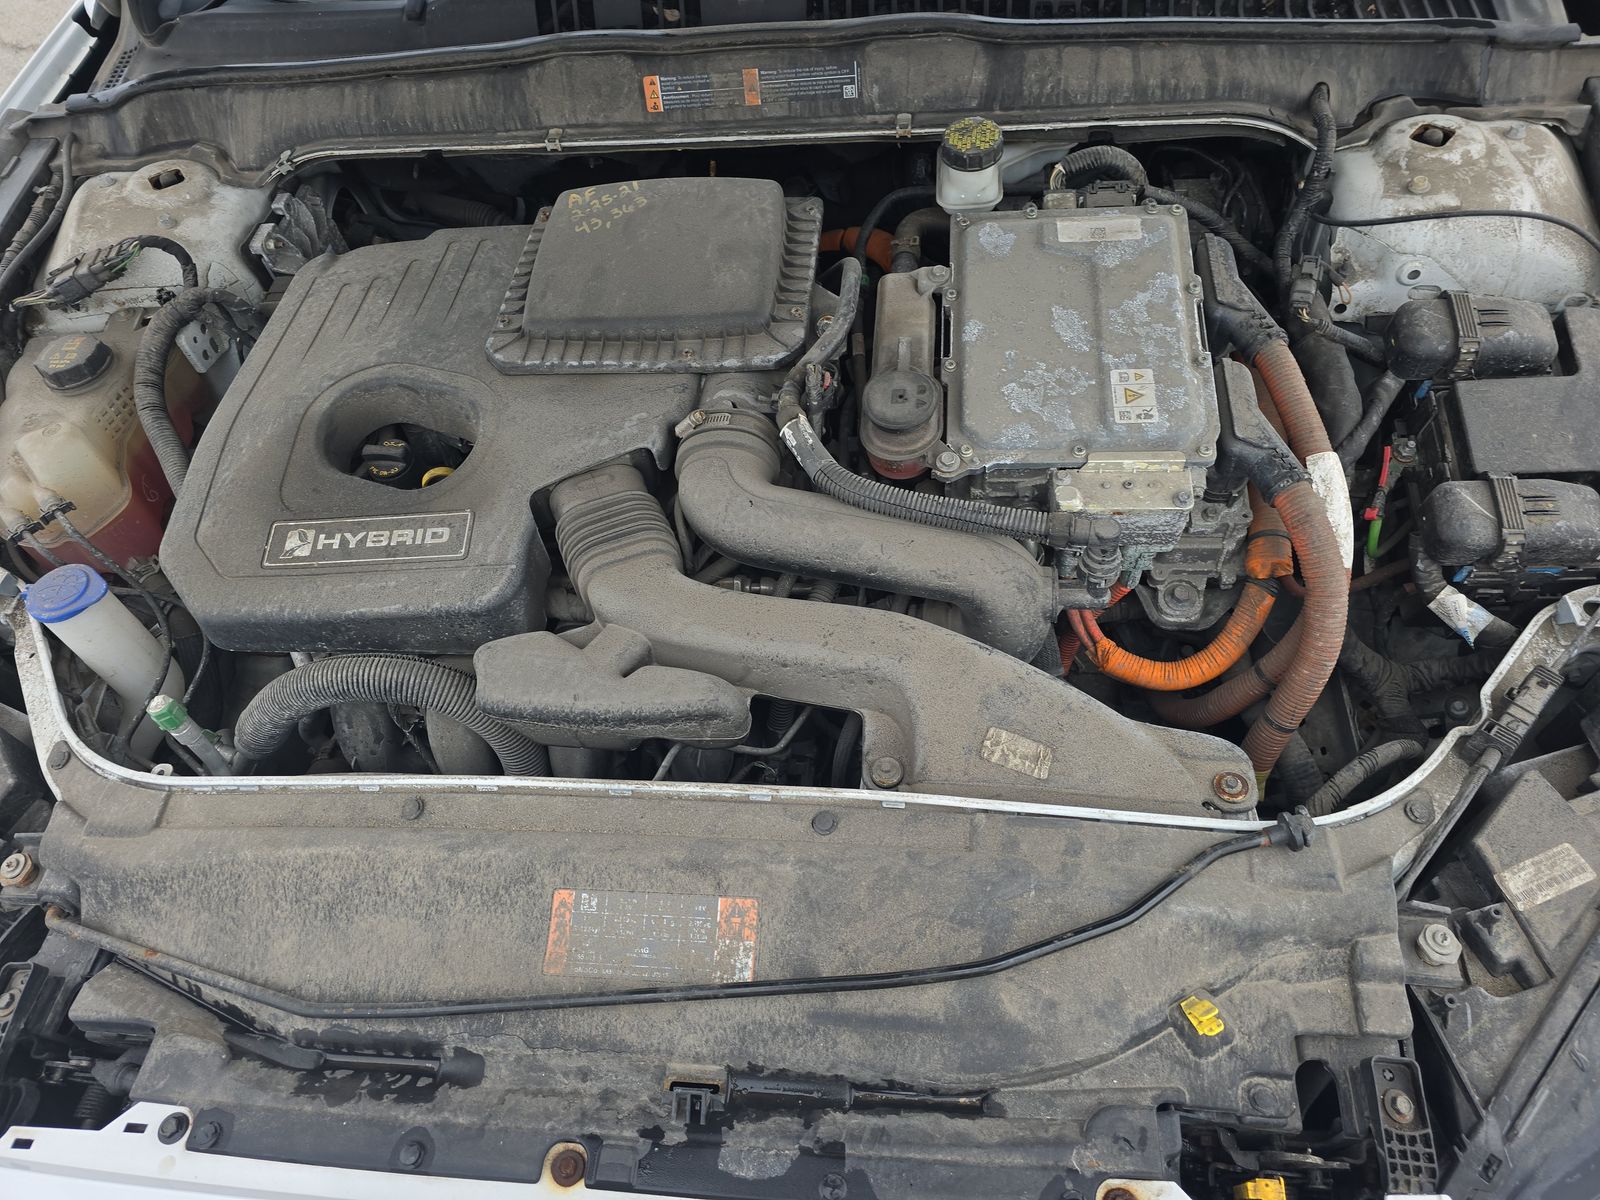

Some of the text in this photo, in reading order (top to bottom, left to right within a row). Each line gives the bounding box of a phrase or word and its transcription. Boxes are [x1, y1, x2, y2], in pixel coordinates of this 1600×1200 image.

[568, 187, 597, 209] AF
[571, 181, 640, 221] 2-25-21
[316, 527, 451, 550] HYBRID
